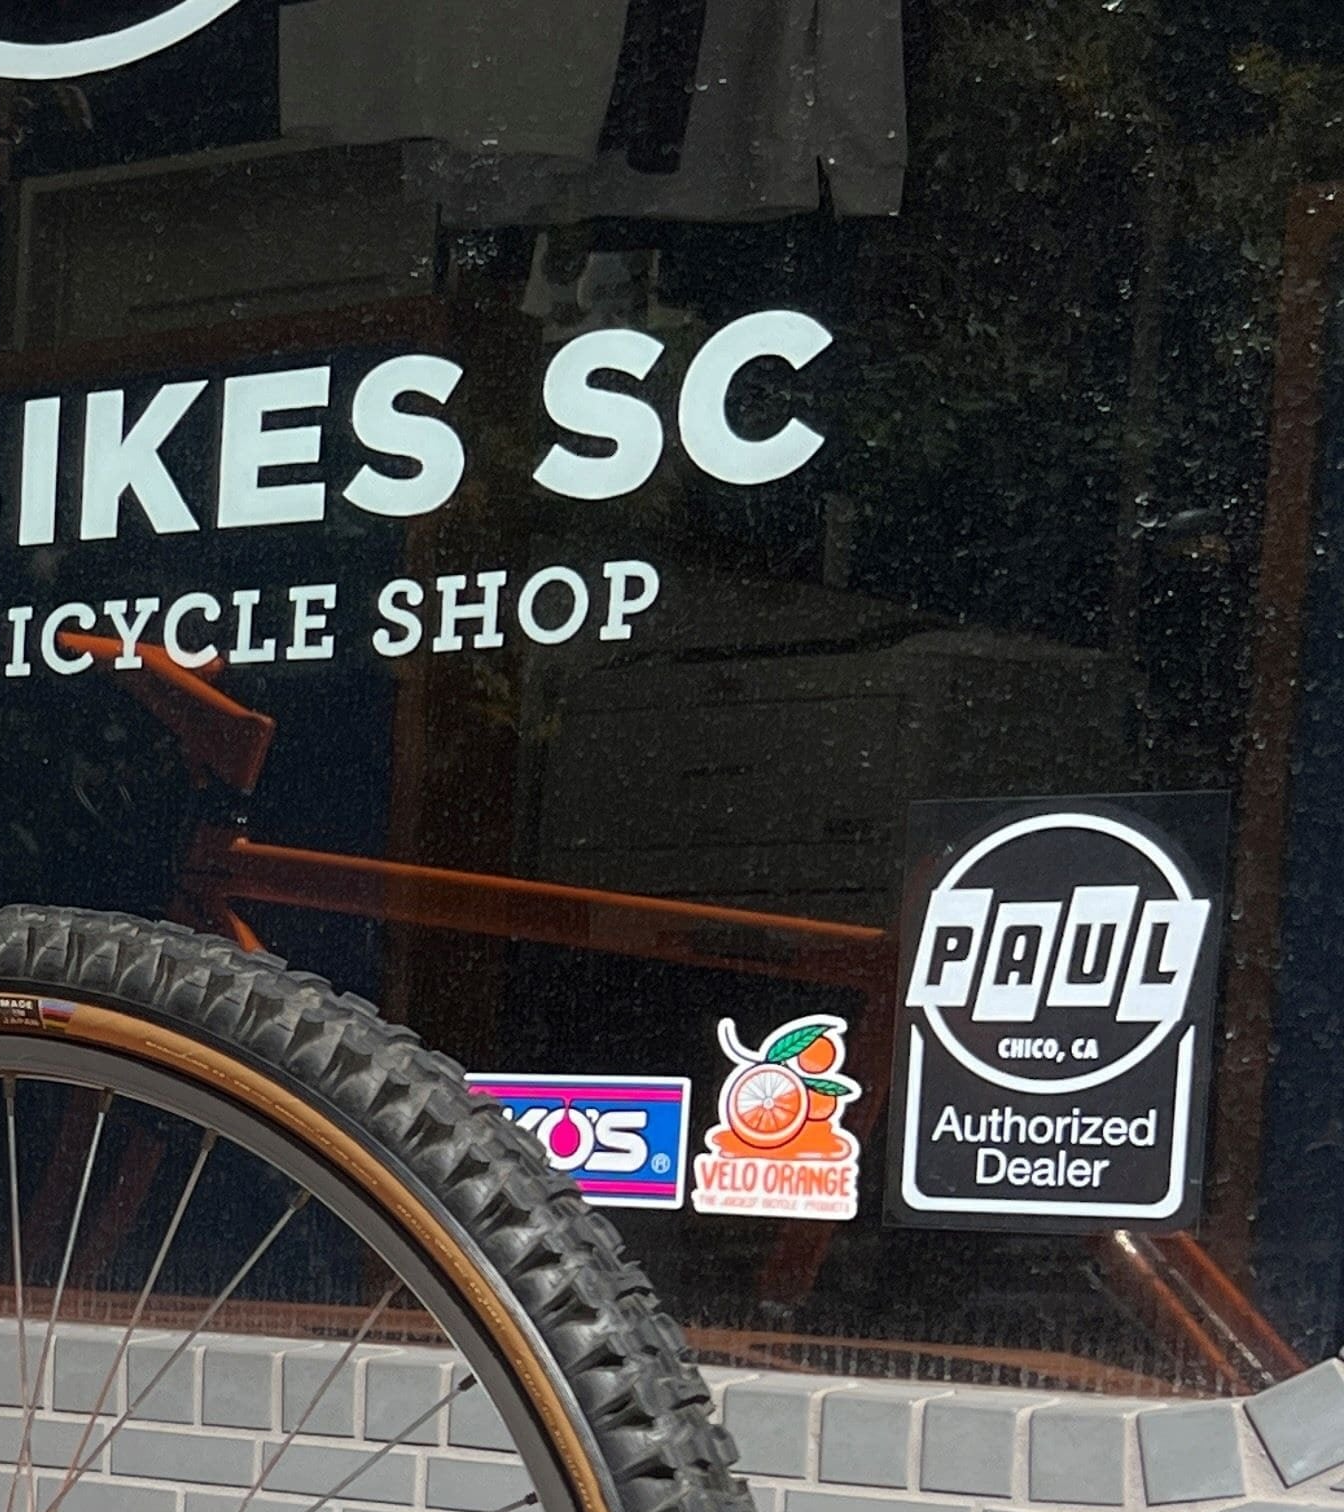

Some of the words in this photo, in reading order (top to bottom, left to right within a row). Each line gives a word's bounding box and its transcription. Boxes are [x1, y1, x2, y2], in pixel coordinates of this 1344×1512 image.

[532, 310, 833, 500] SC
[372, 561, 660, 657] SHOP
[919, 910, 1186, 995] PAUL
[0, 999, 33, 1010] MADE
[998, 1038, 1066, 1063] CHICO,
[1071, 1039, 1100, 1060] CA
[931, 1105, 1157, 1147] Authorized
[701, 1161, 758, 1192] VELO
[762, 1163, 852, 1197] ORANGE
[975, 1148, 1110, 1188] Dealer
